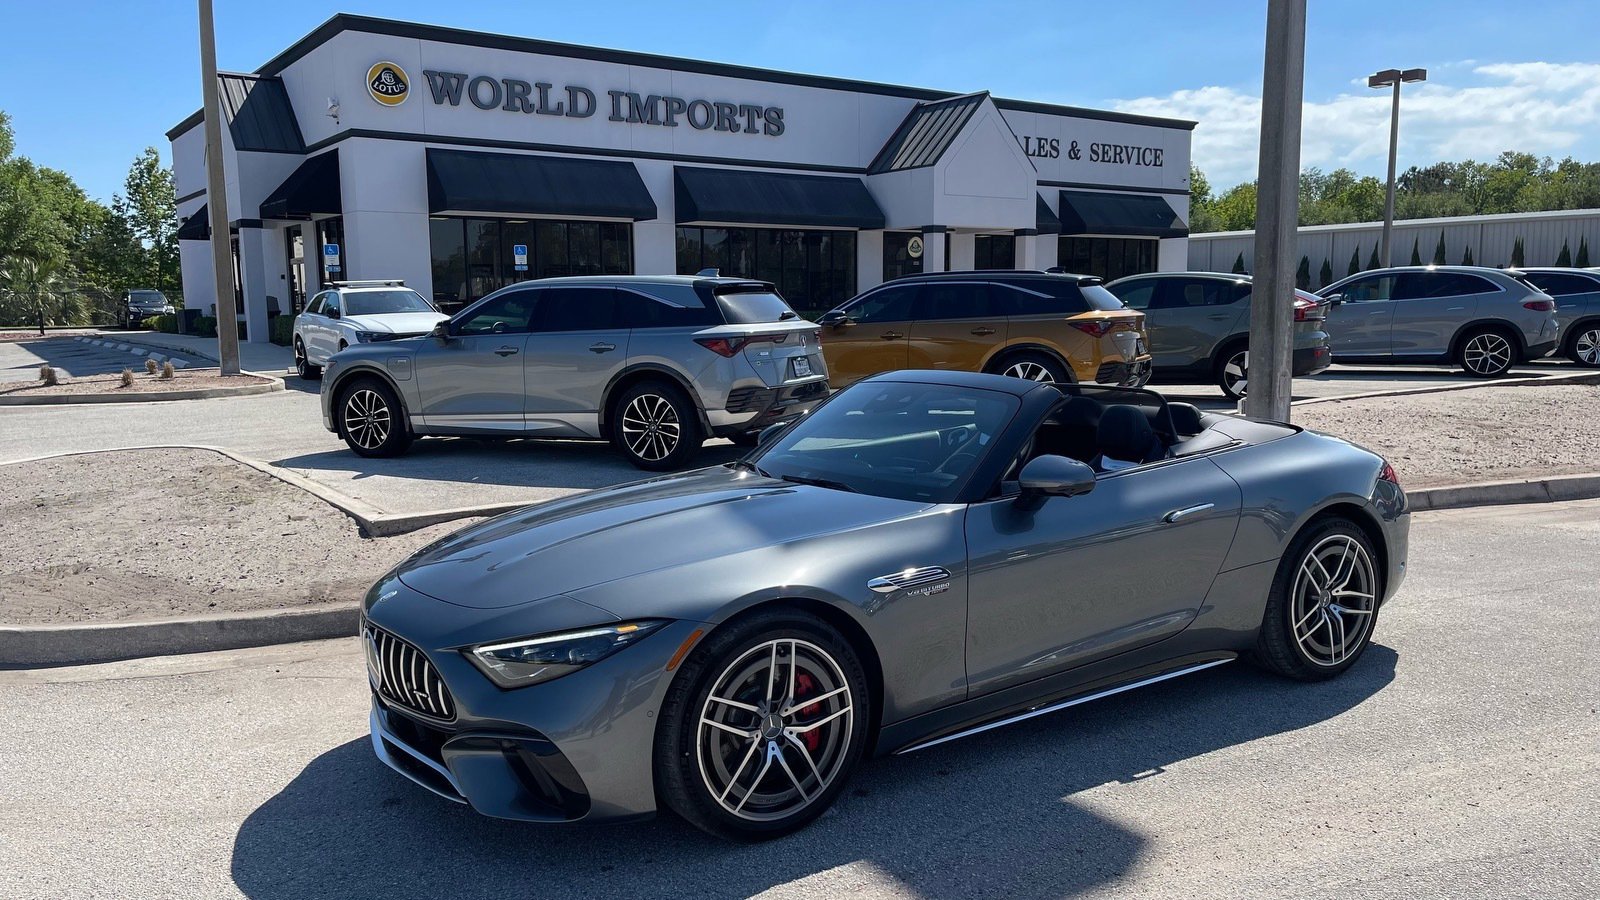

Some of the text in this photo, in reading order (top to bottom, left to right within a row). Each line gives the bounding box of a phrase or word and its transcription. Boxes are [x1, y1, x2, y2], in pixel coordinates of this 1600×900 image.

[373, 81, 405, 93] LOTUS
[424, 70, 786, 137] WORLD IMPORTS
[1023, 136, 1163, 167] LES & SERVICE
